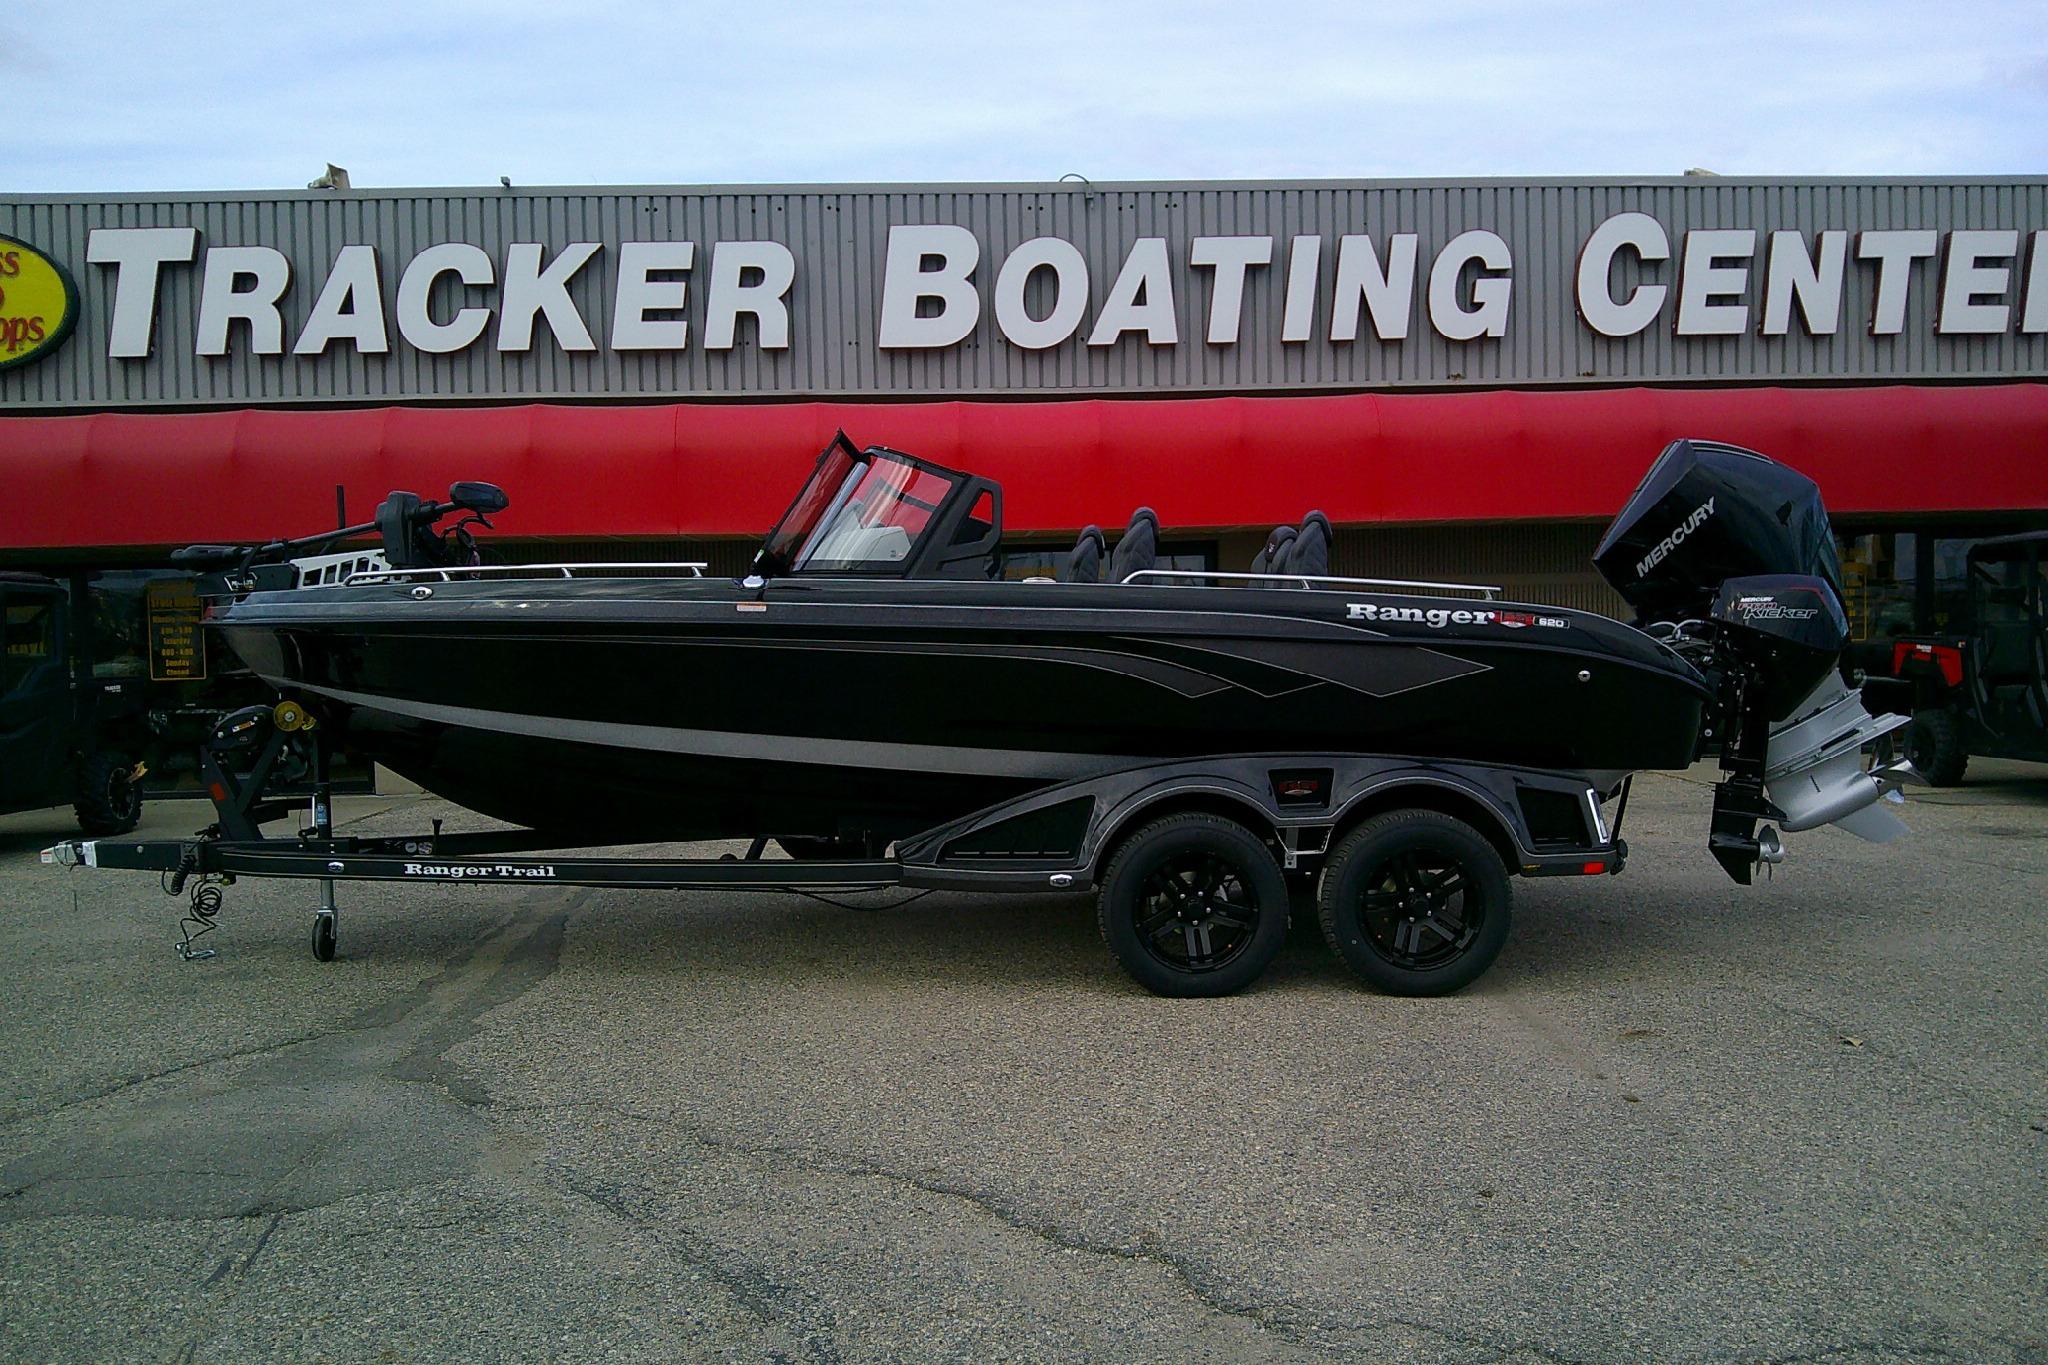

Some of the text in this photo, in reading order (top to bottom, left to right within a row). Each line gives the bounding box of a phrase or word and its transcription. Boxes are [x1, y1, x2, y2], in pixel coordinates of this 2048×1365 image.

[87, 228, 796, 358] TRACKER
[879, 225, 1513, 350] BOATING
[1636, 496, 1715, 578] MERCURY
[1346, 602, 1495, 629] Ranger
[1538, 617, 1565, 628] 620
[404, 863, 557, 878] Ranger Trail
